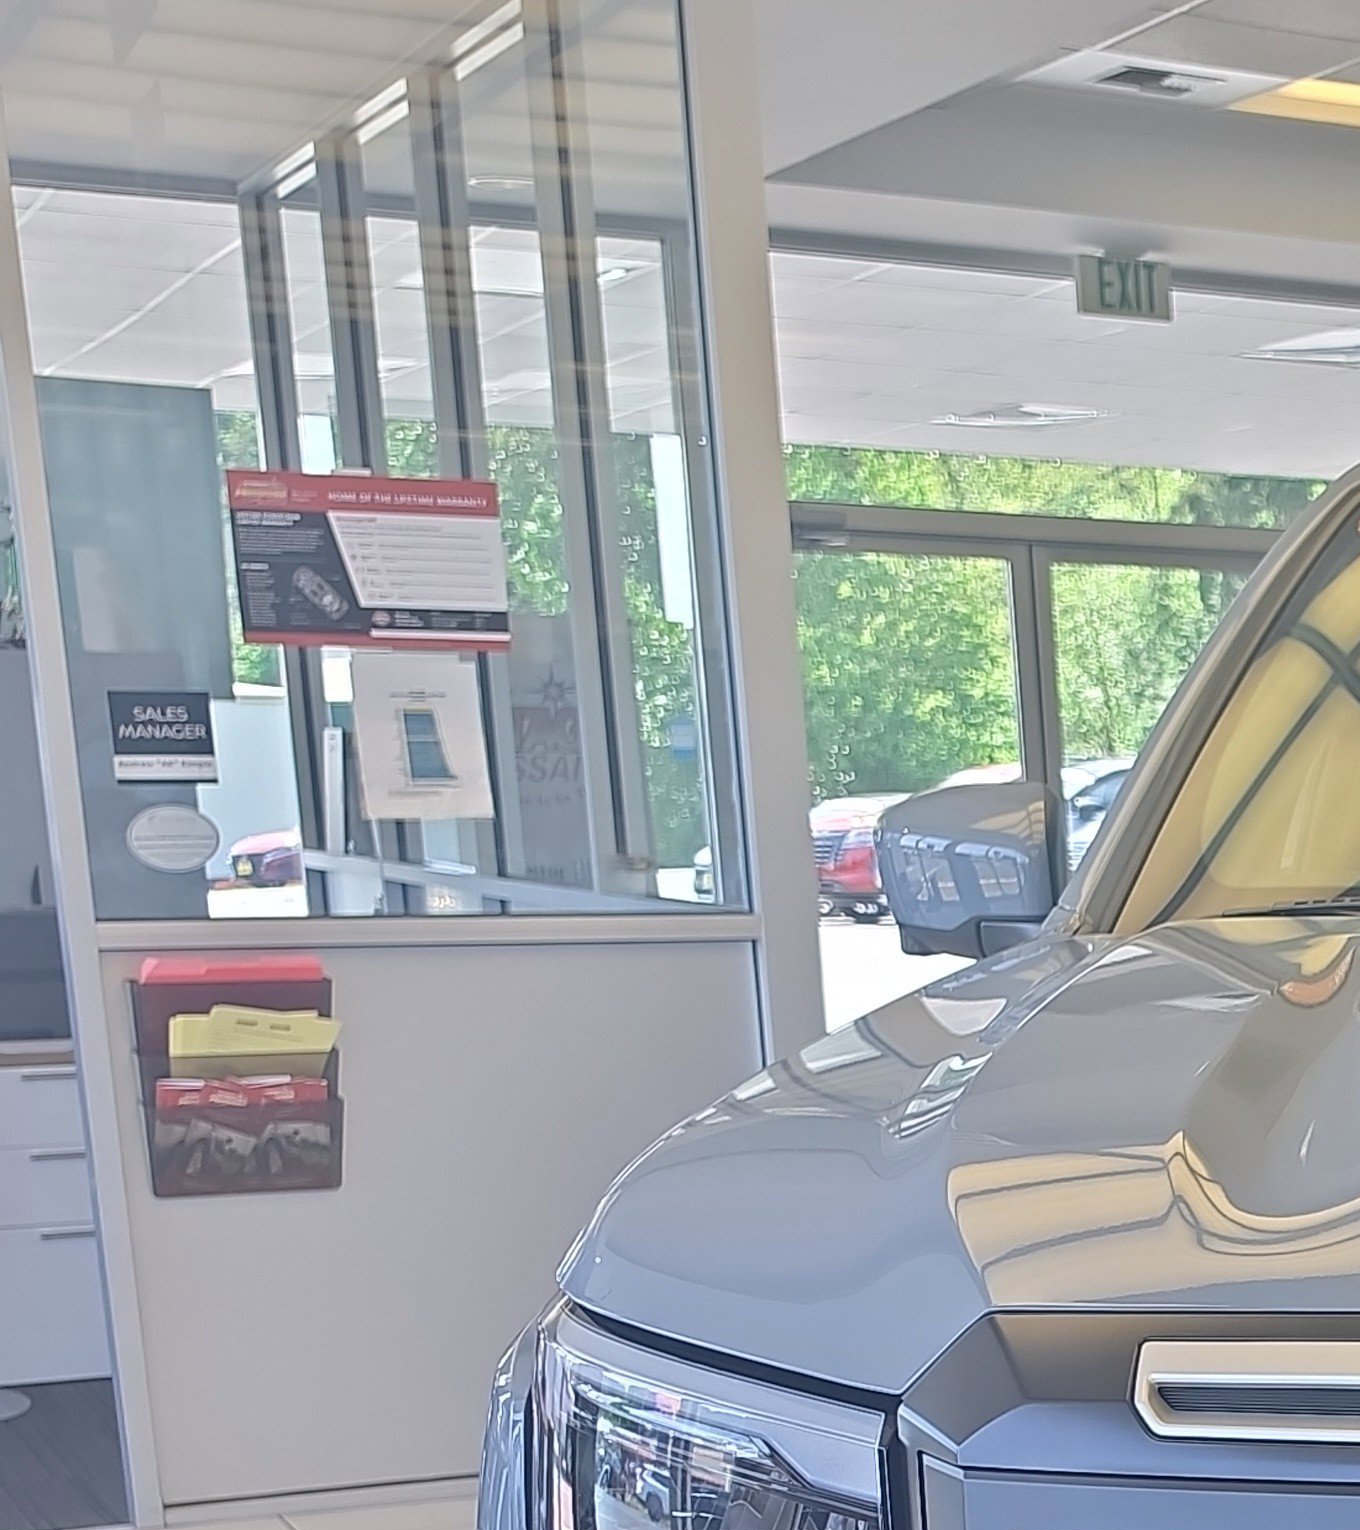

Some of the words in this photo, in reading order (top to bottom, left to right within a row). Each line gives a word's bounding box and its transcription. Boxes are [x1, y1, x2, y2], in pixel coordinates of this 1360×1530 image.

[1099, 260, 1157, 312] EXIT
[132, 705, 189, 722] SALES
[118, 723, 208, 740] MANAGER
